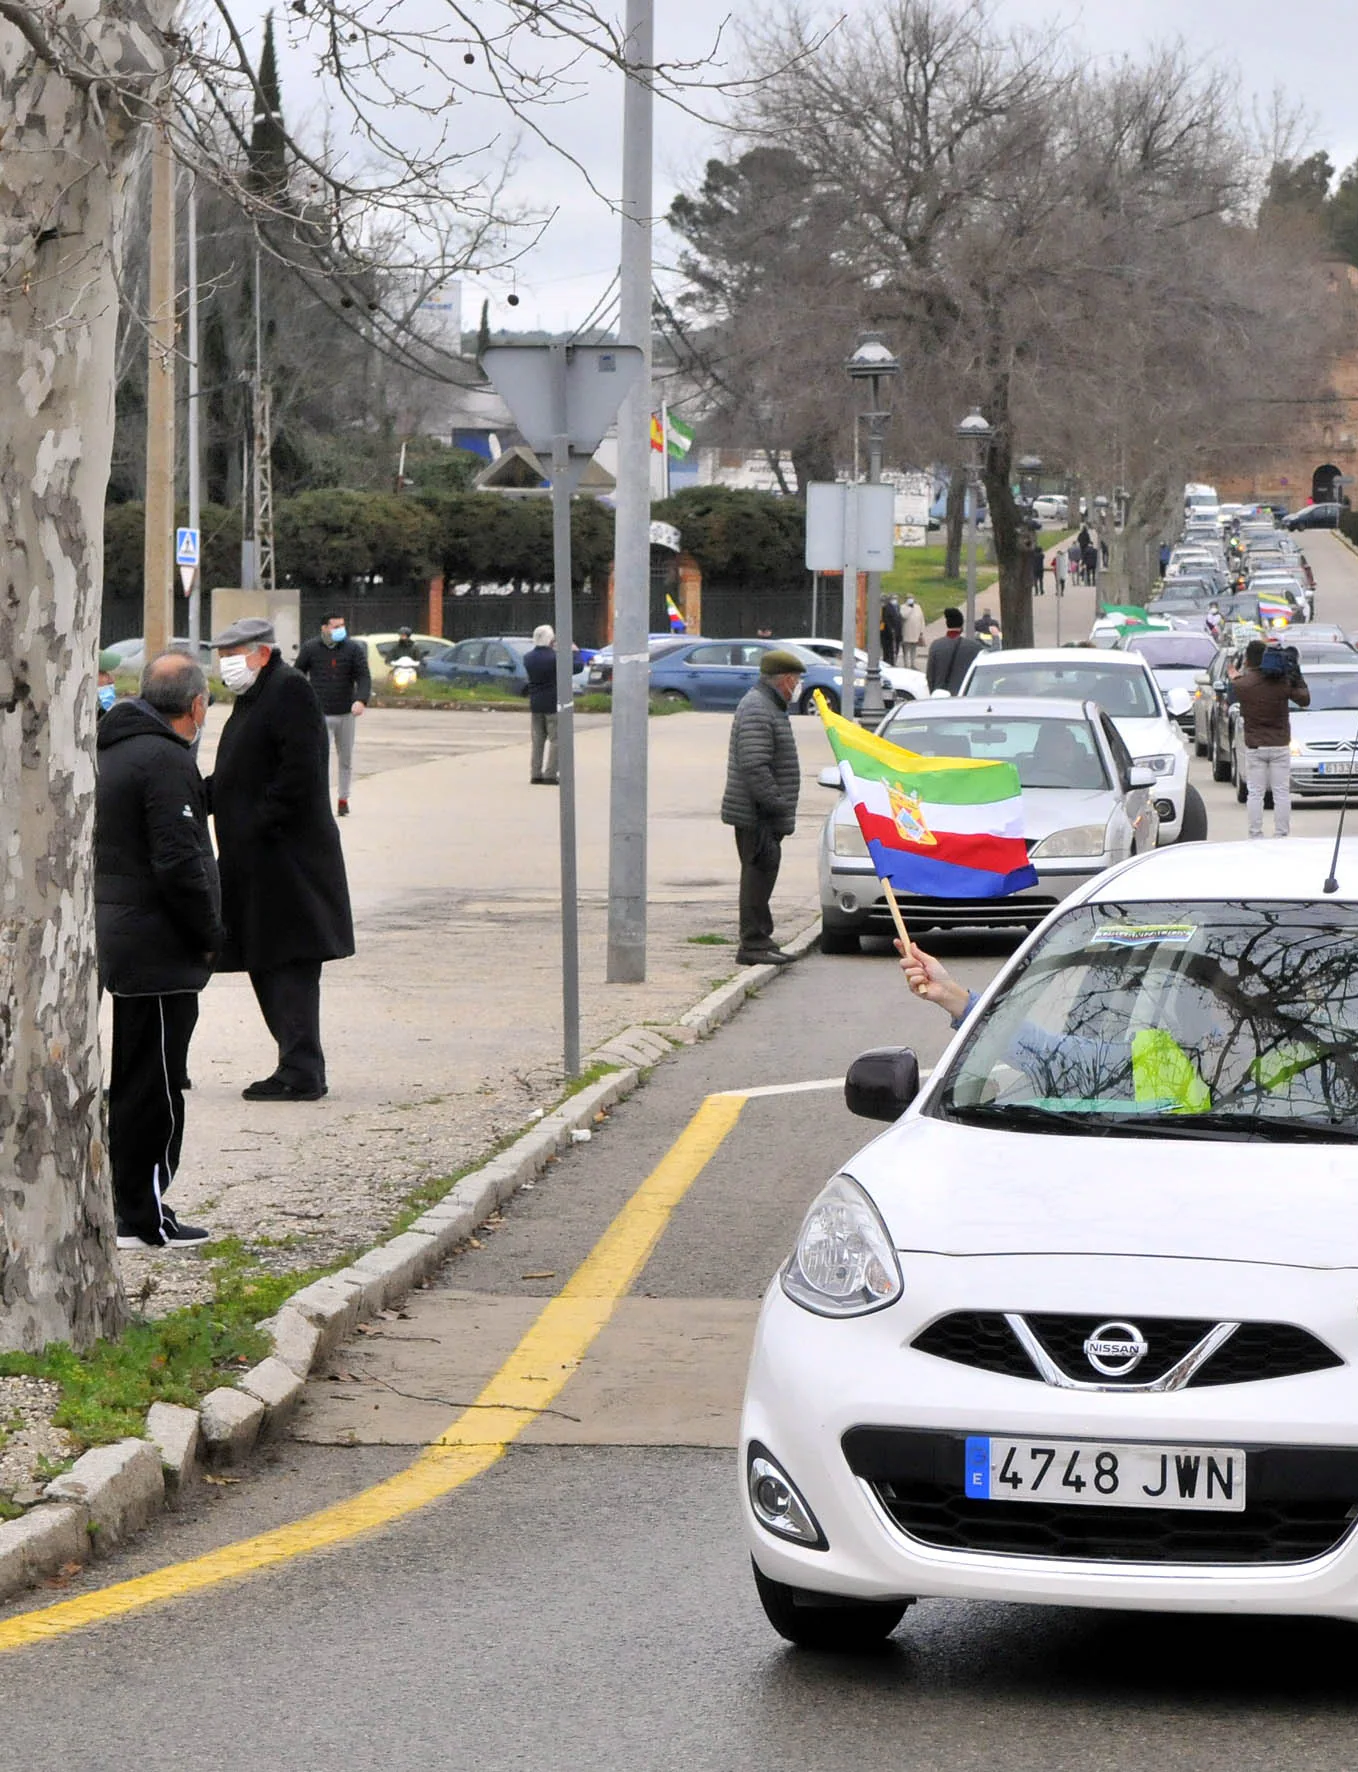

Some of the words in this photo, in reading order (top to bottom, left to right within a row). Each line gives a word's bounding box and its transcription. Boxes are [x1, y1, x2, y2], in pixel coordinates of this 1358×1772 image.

[1089, 1343, 1140, 1354] NISSAN
[972, 1472, 983, 1485] E
[998, 1446, 1120, 1495] 4748
[1142, 1454, 1234, 1501] JWN
